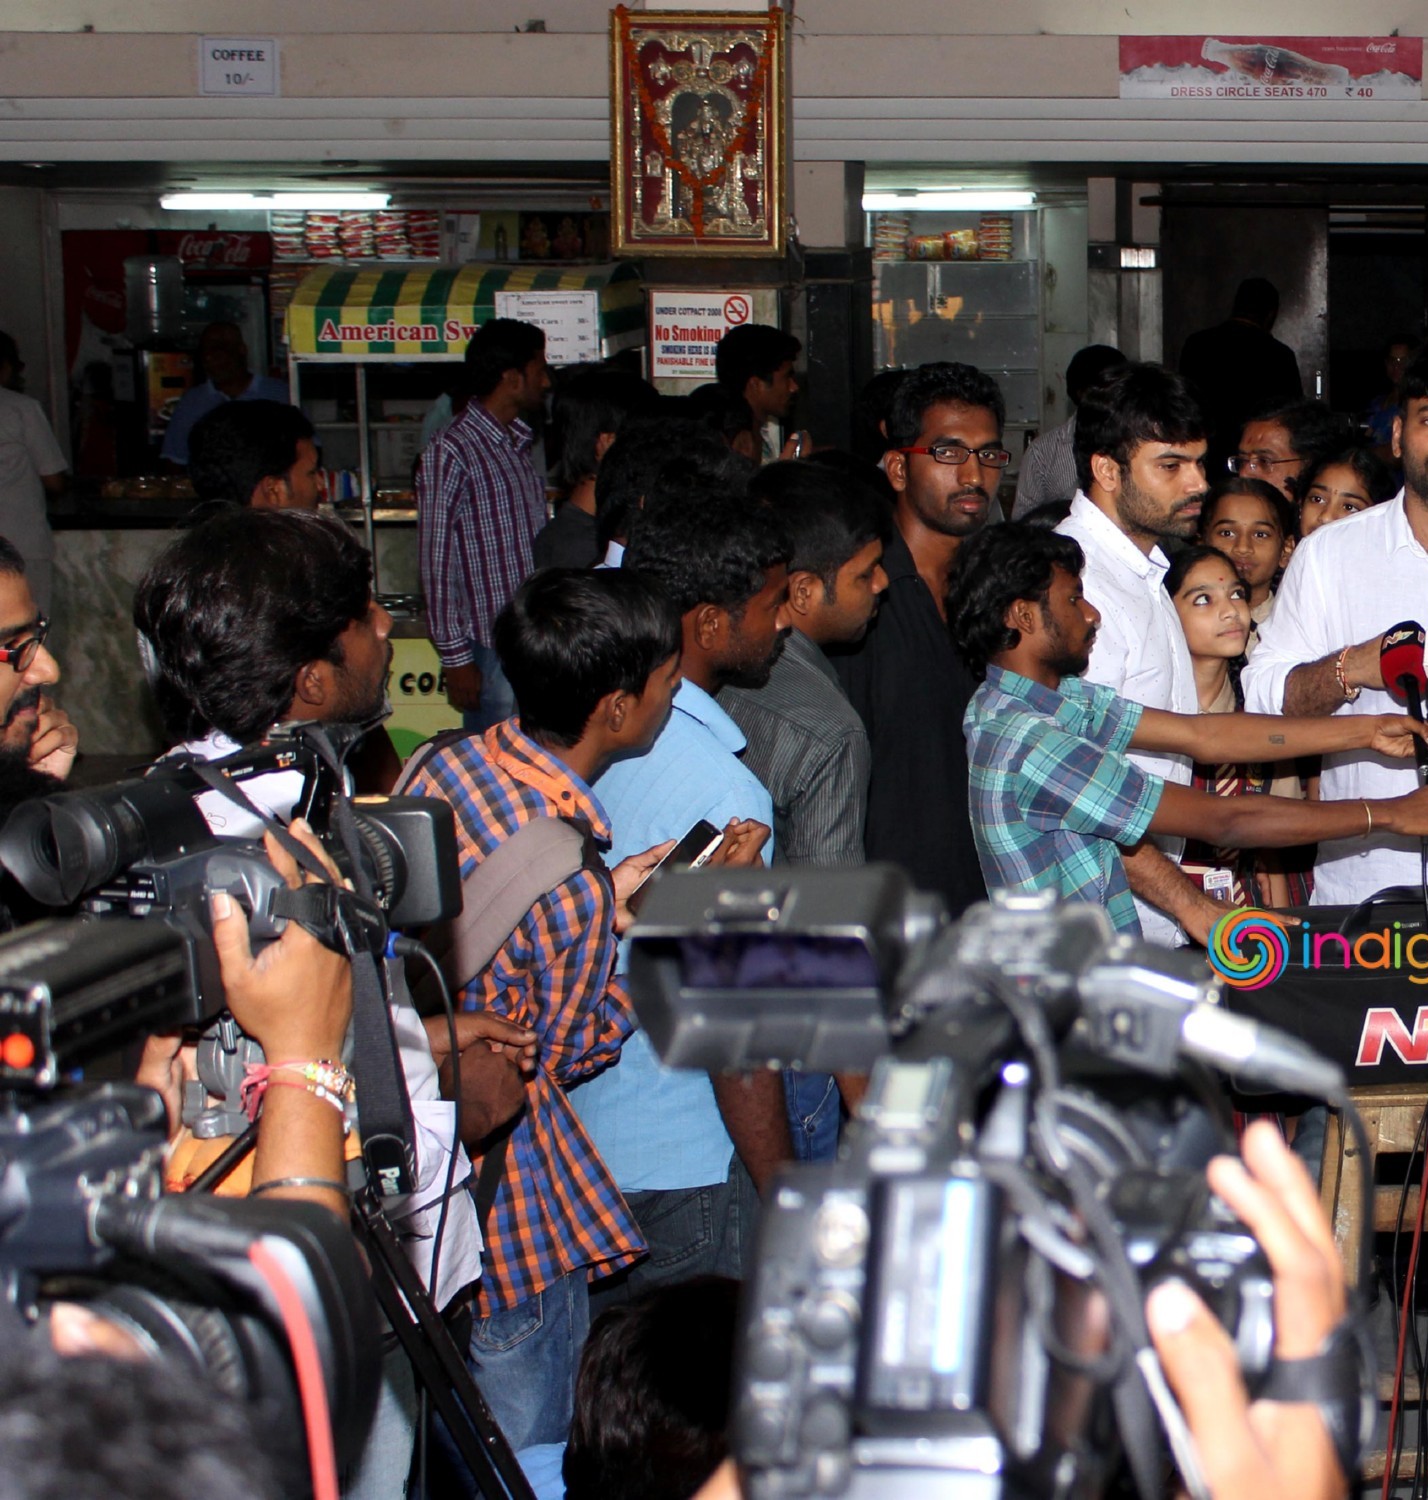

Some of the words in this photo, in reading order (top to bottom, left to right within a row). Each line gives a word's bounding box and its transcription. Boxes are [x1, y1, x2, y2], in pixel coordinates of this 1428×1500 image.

[212, 49, 265, 62] COFFEE
[225, 72, 255, 86] 10/-
[1170, 86, 1213, 98] DRESS
[1215, 86, 1261, 98] CIRCLE
[1264, 87, 1304, 98] SEATS
[1306, 87, 1328, 98] 470
[1357, 87, 1374, 98] 40
[655, 306, 677, 316] UNDER
[318, 318, 440, 342] American
[443, 319, 482, 342] Sw
[655, 325, 670, 341] No
[672, 325, 721, 343] Smoking
